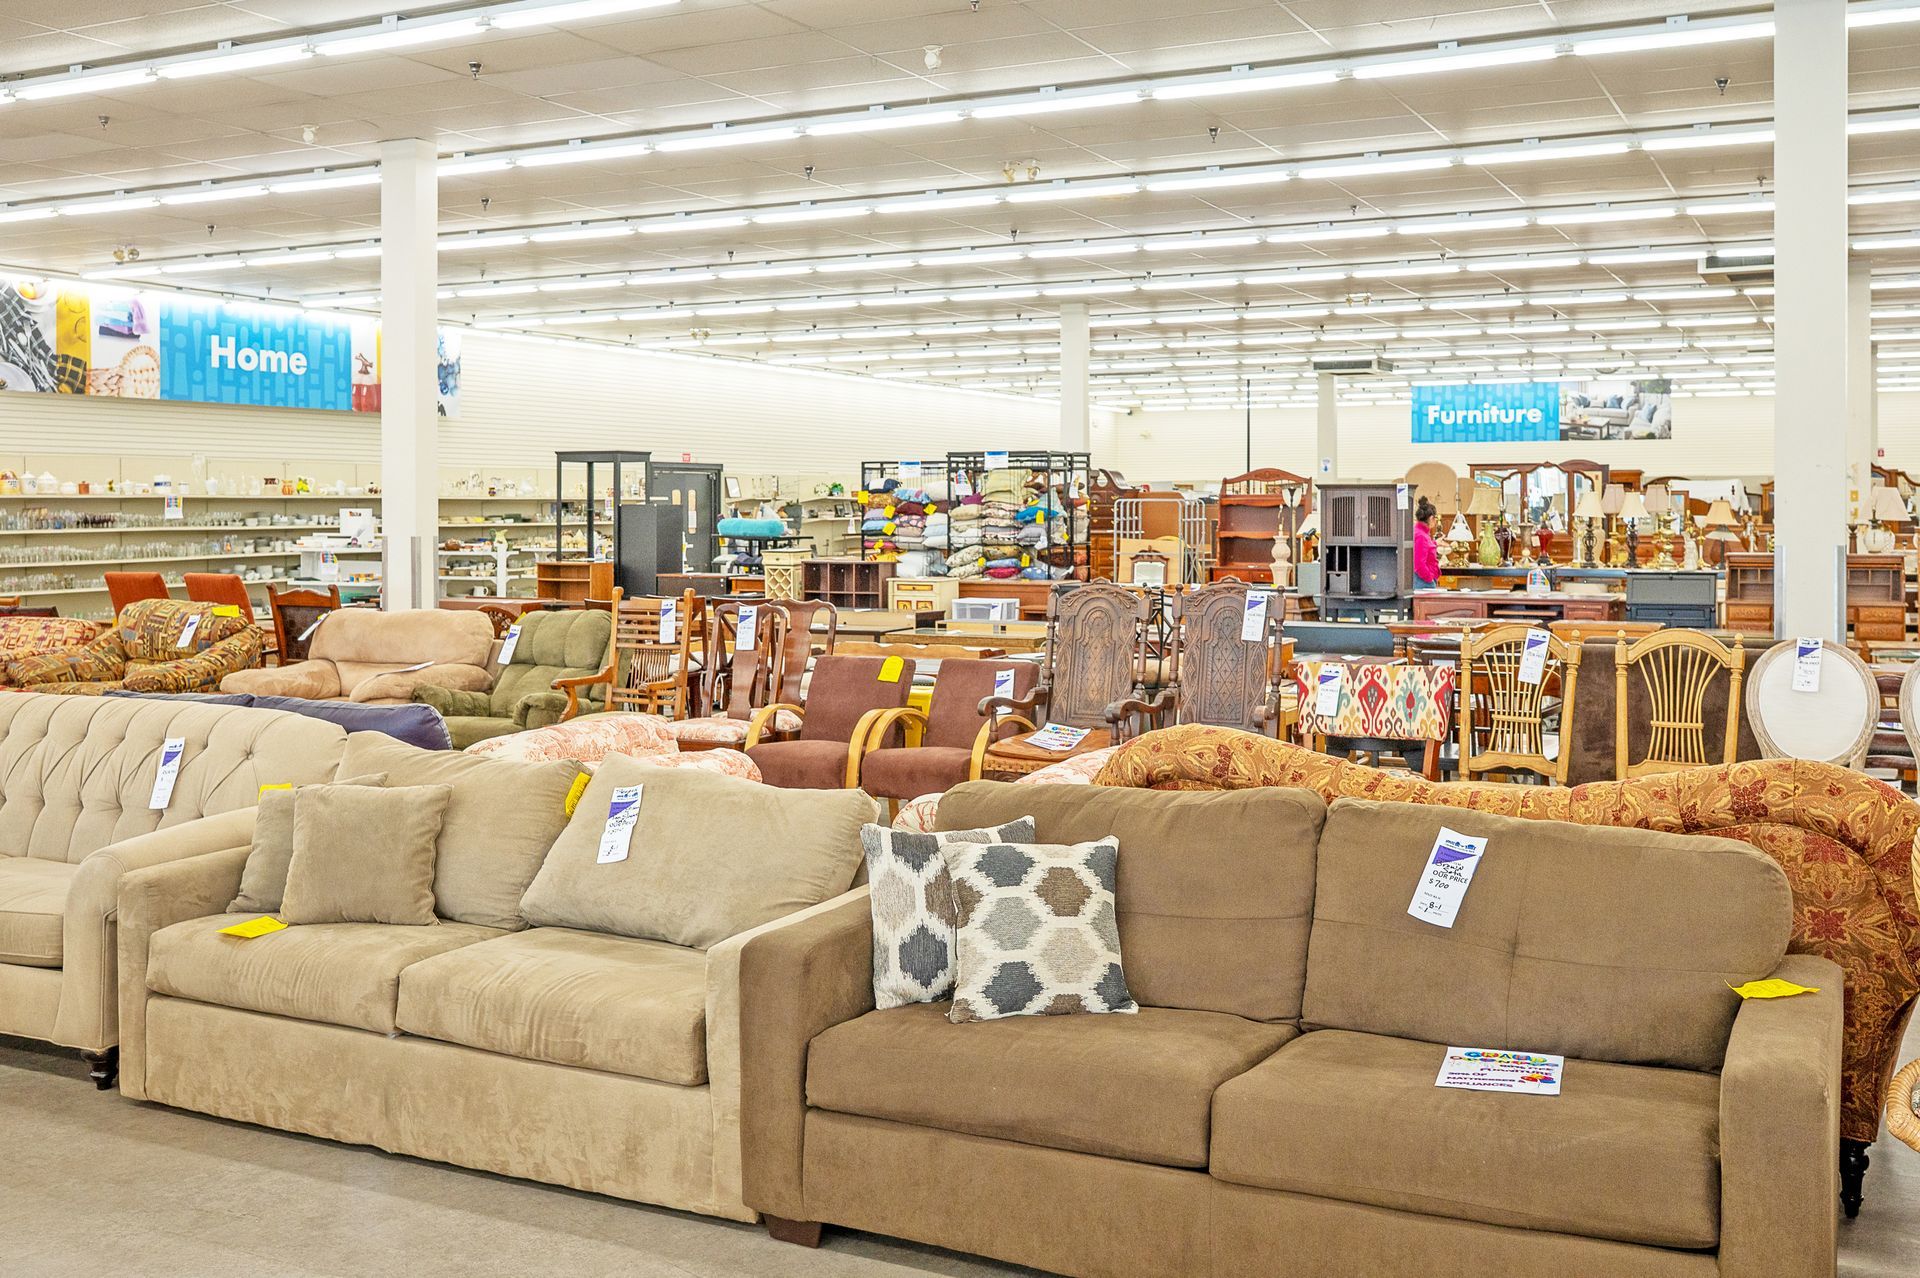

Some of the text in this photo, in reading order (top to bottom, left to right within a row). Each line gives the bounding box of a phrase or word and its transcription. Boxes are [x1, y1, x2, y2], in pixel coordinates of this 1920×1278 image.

[211, 334, 307, 375] Home
[1428, 402, 1542, 424] Furniture
[1432, 869, 1469, 884] OUR PRICE
